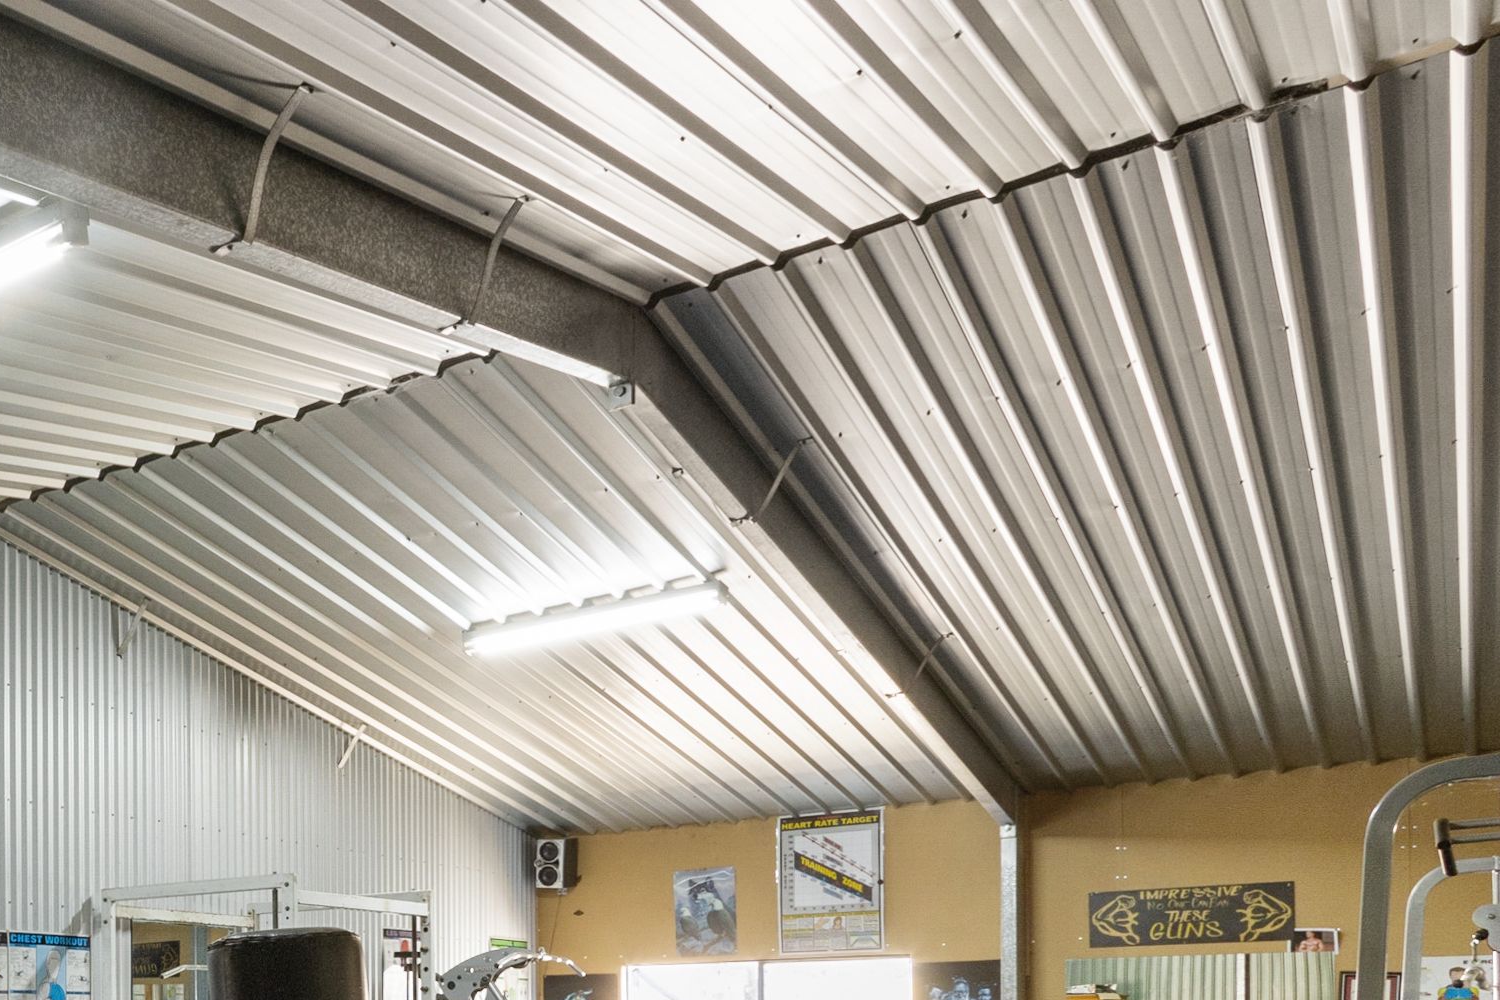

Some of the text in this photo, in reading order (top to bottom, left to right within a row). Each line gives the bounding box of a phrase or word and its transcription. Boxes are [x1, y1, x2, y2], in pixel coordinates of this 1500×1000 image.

[781, 821, 812, 830] HEART
[814, 818, 839, 827] RATE
[840, 815, 878, 824] TARGET
[801, 855, 837, 880] TRAINING
[1140, 886, 1242, 900] IMPRESSIVE
[1164, 909, 1210, 922] THESE
[1149, 921, 1223, 940] GUNS
[10, 933, 88, 947] CHEST WORKOUT
